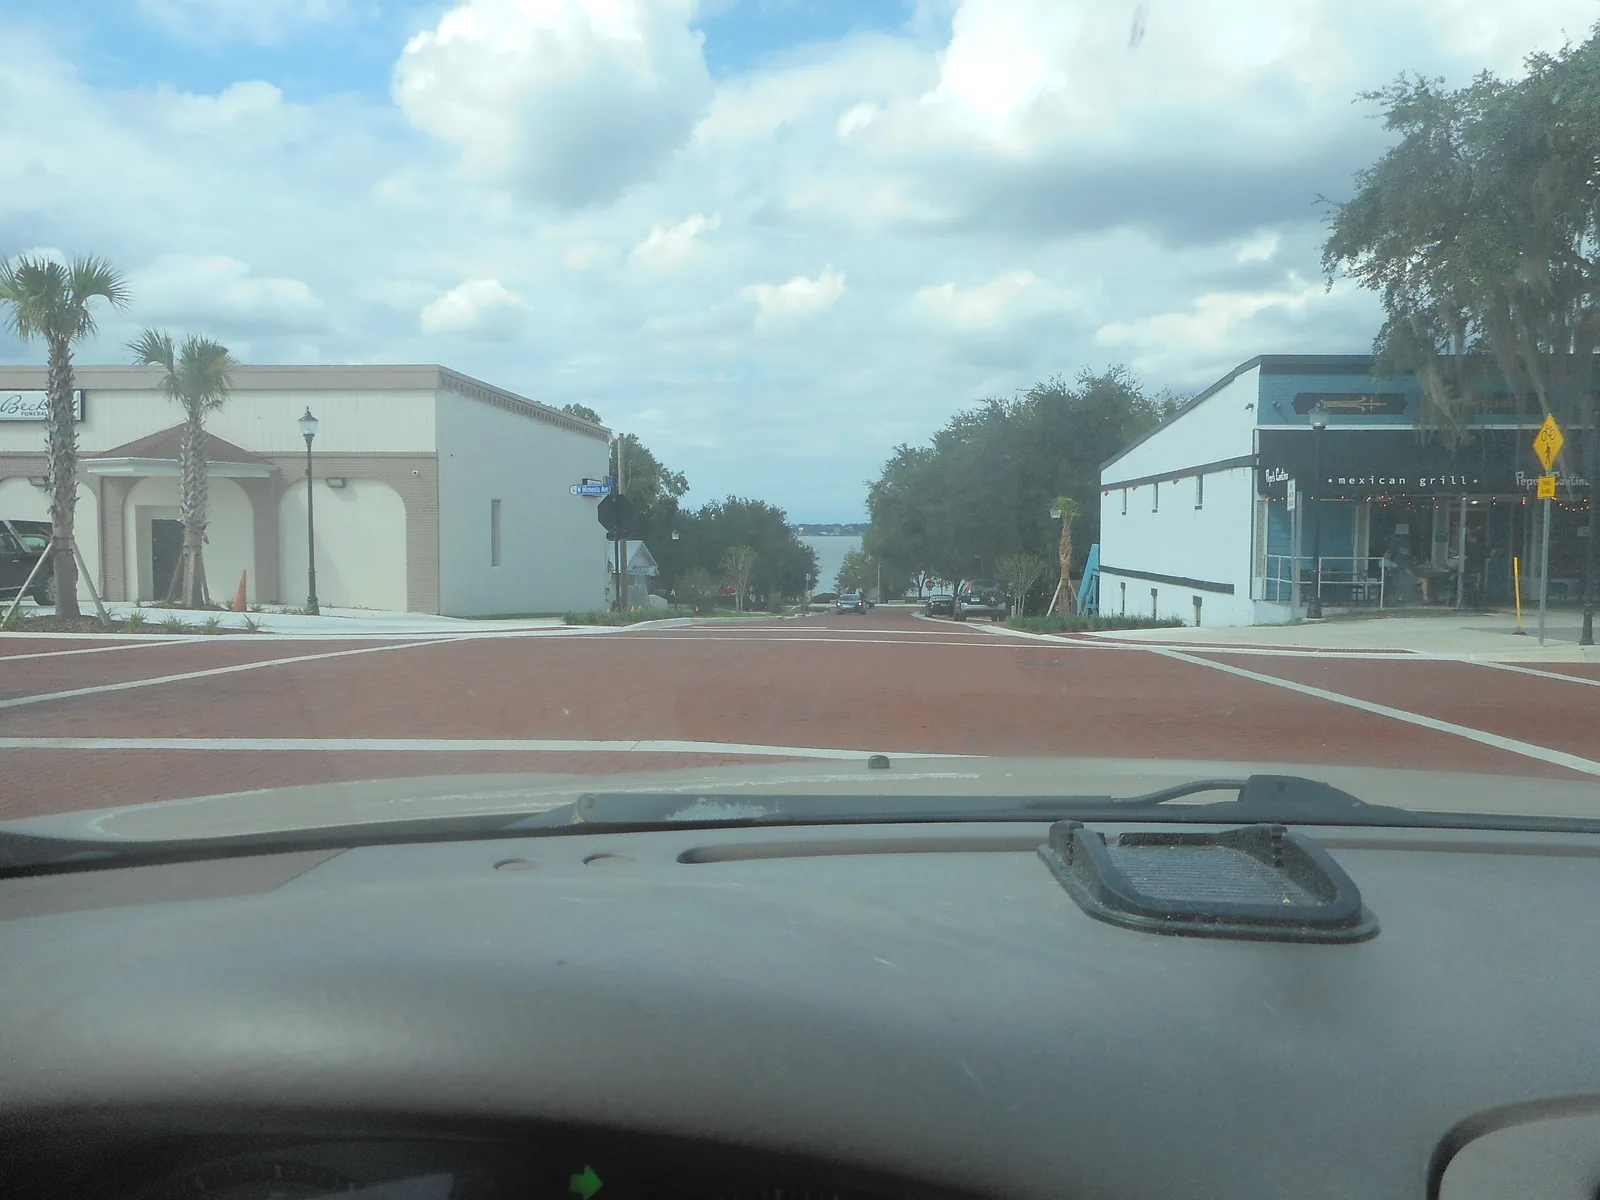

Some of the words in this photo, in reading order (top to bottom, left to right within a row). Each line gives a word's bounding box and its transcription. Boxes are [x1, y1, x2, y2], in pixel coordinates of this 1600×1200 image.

[1338, 475, 1406, 485] mexican
[1419, 475, 1467, 487] grill
[1515, 471, 1547, 490] Pepe
